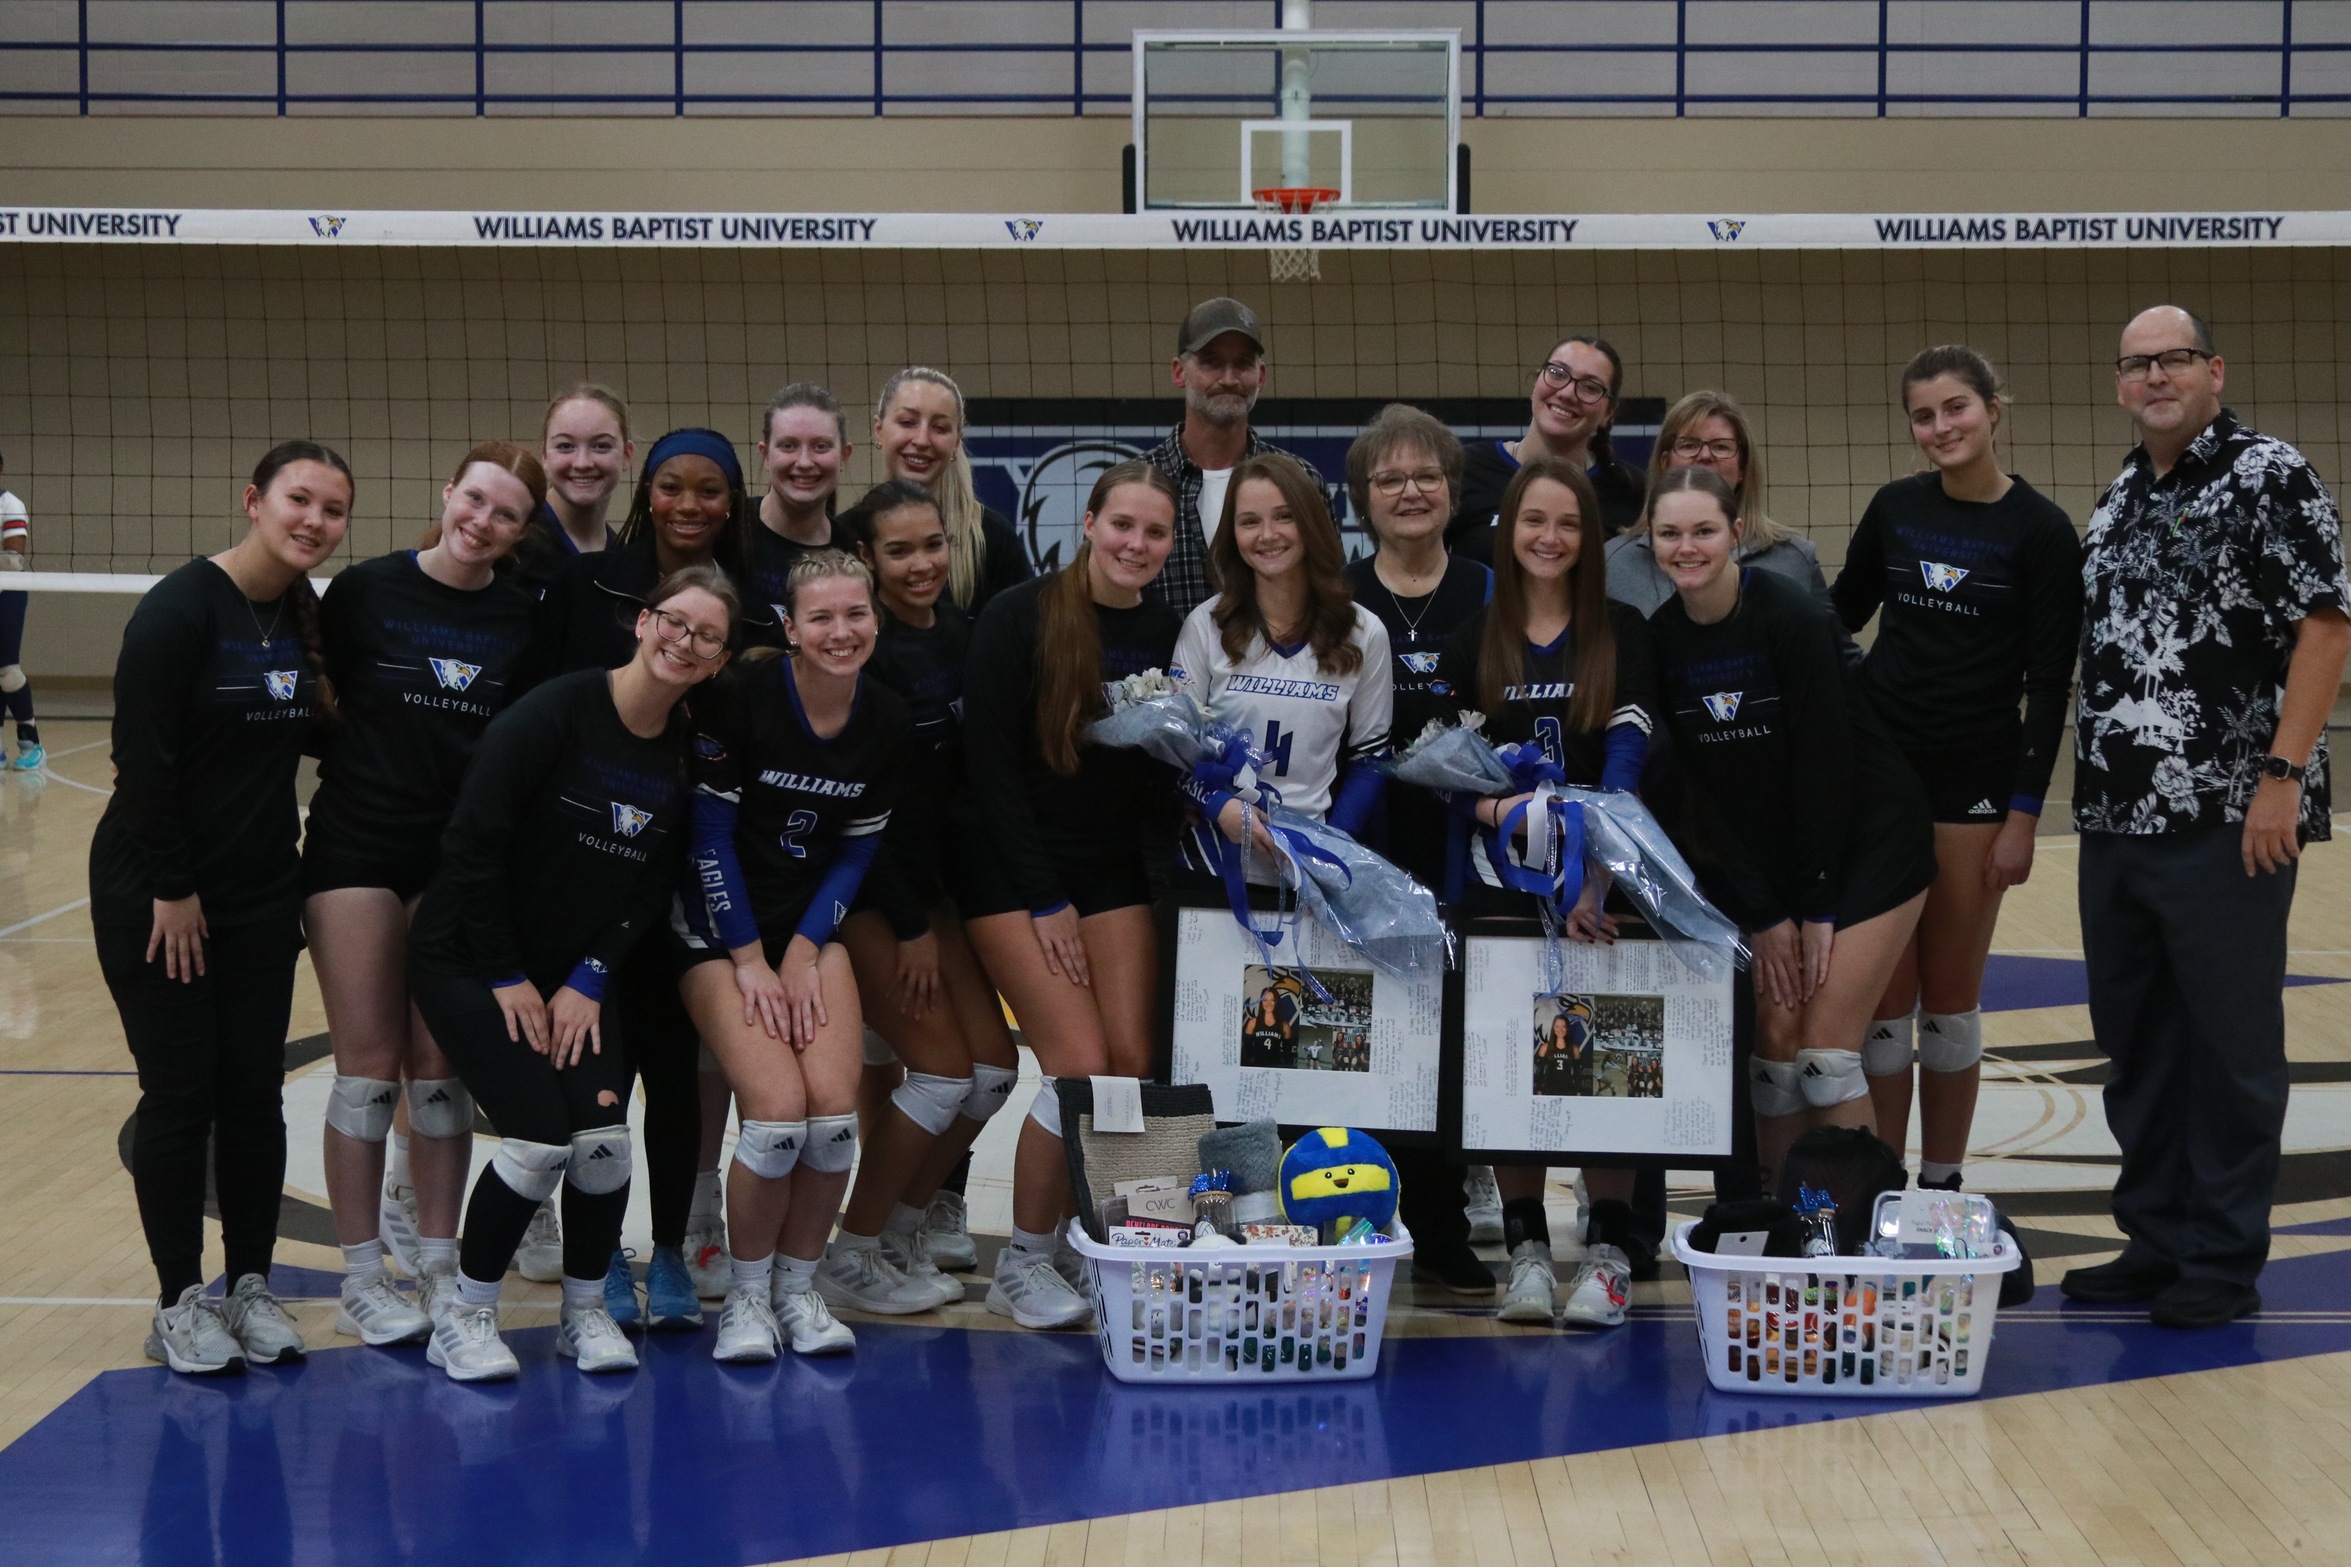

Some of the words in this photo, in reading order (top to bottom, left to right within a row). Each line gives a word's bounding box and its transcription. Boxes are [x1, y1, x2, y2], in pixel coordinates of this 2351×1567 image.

[27, 213, 182, 237] UNIVERSITY
[473, 216, 605, 240] WILLIAMS
[611, 217, 713, 241] BAPTIST
[720, 217, 877, 241] UNIVERSITY
[1171, 218, 1303, 243] WILLIAMS
[1310, 219, 1413, 243] BAPTIST
[1420, 219, 1579, 242] UNIVERSITY
[1875, 218, 2006, 242] WILLIAMS
[2015, 218, 2118, 241] BAPTIST
[2124, 216, 2284, 241] UNIVERSITY
[1897, 591, 1980, 616] VOLLEYBALL
[1226, 674, 1340, 702] WILLIAMS
[246, 707, 315, 721] VOLLEYBAL
[403, 692, 492, 717] VOLLEYBALL
[1534, 716, 1566, 776] 3
[1698, 725, 1772, 743] VOLLEYBALL
[757, 769, 867, 799] WILLIAMS
[779, 809, 818, 860] 2
[578, 832, 648, 864] VOLLEYBALL
[1263, 1038, 1272, 1051] 4
[1556, 1059, 1564, 1071] 3
[1145, 1198, 1176, 1212] CWC
[1111, 1233, 1144, 1248] Paper
[1149, 1235, 1177, 1248] Mate
